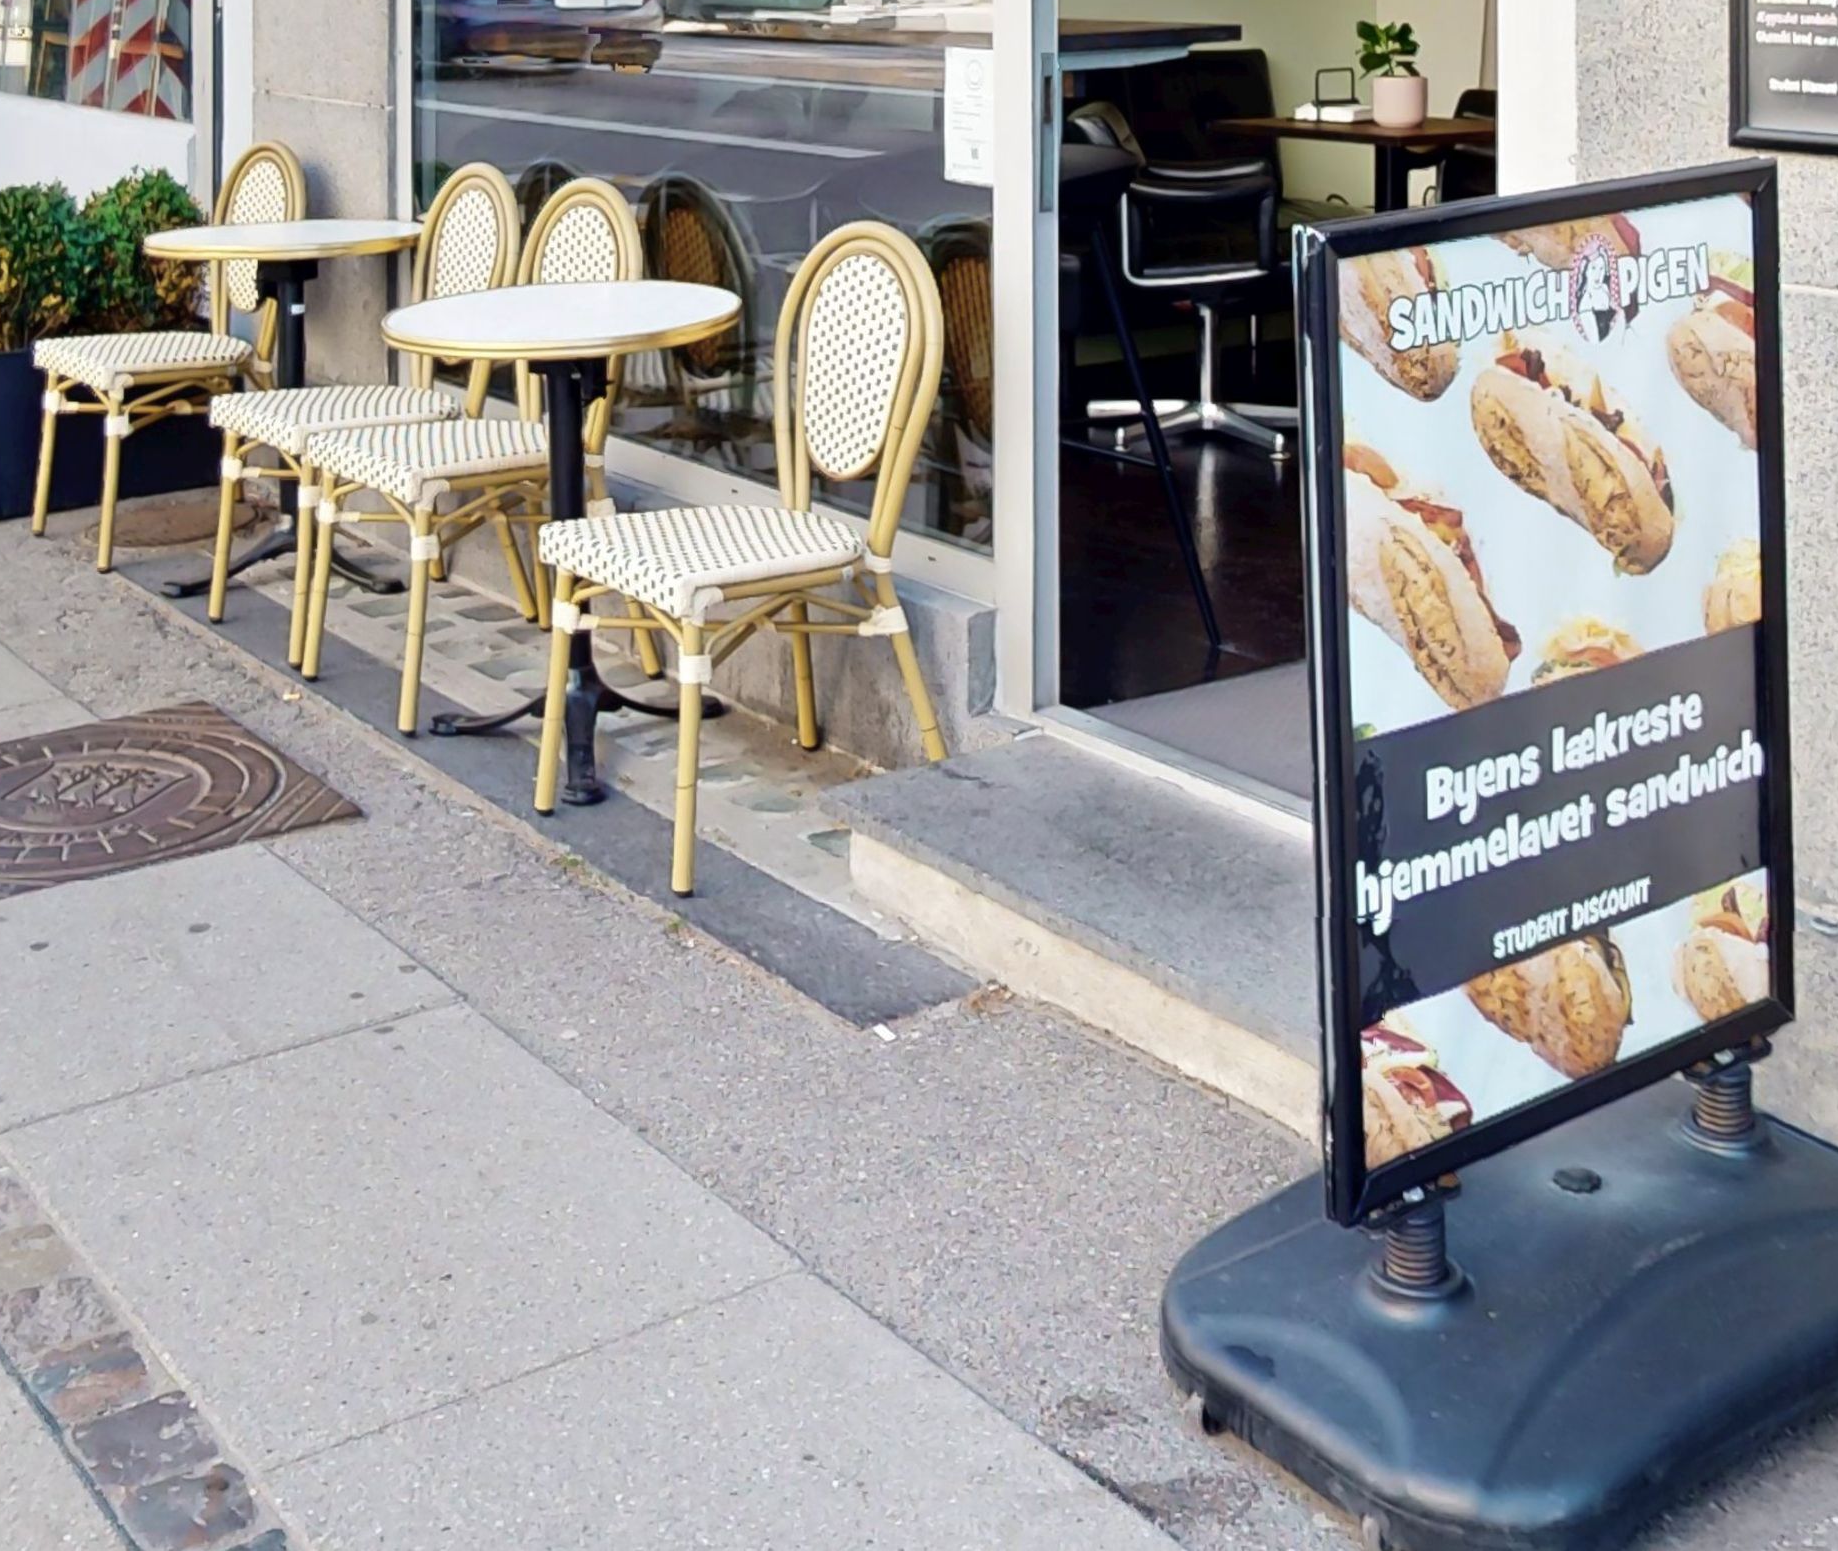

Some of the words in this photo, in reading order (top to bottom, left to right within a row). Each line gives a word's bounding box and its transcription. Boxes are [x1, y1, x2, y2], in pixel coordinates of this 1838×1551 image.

[1388, 268, 1571, 352] SANDWICH
[1618, 243, 1710, 309] PIGEN
[1426, 745, 1541, 825] Byens
[1552, 693, 1703, 774] lækreste
[1355, 794, 1596, 936] hjemmelavet
[1606, 728, 1765, 827] sandwich
[1493, 908, 1569, 960] STUDENT
[1571, 876, 1652, 931] DISCOUNT
